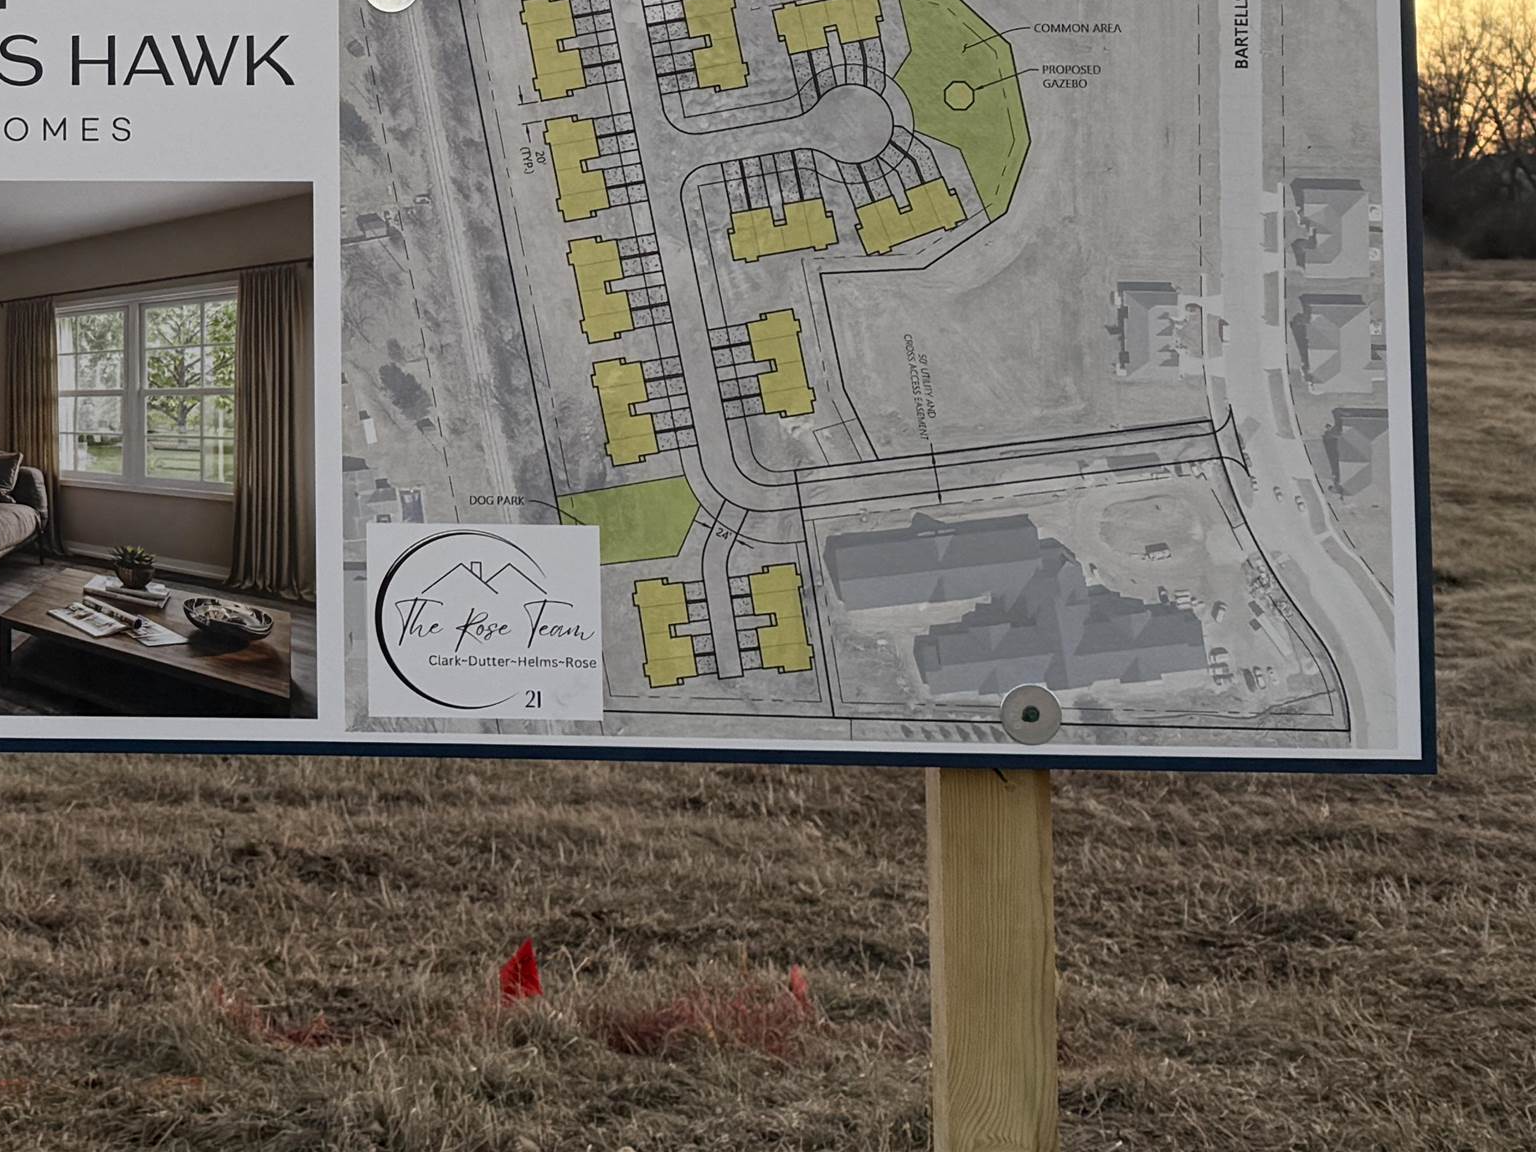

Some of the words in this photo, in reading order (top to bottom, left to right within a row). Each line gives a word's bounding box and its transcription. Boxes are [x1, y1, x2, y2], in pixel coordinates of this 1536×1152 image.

[1033, 23, 1090, 33] COMMON
[1092, 23, 1122, 33] AREA
[71, 35, 296, 87] HAWK
[1042, 64, 1102, 75] PROPOSED
[1042, 79, 1088, 89] GAZEBO
[926, 399, 937, 419] AND
[469, 495, 494, 505] DOG
[497, 495, 525, 505] PARK
[394, 597, 445, 646] The
[454, 607, 512, 653] Rose
[522, 598, 595, 649] Team
[524, 689, 542, 708] 21
